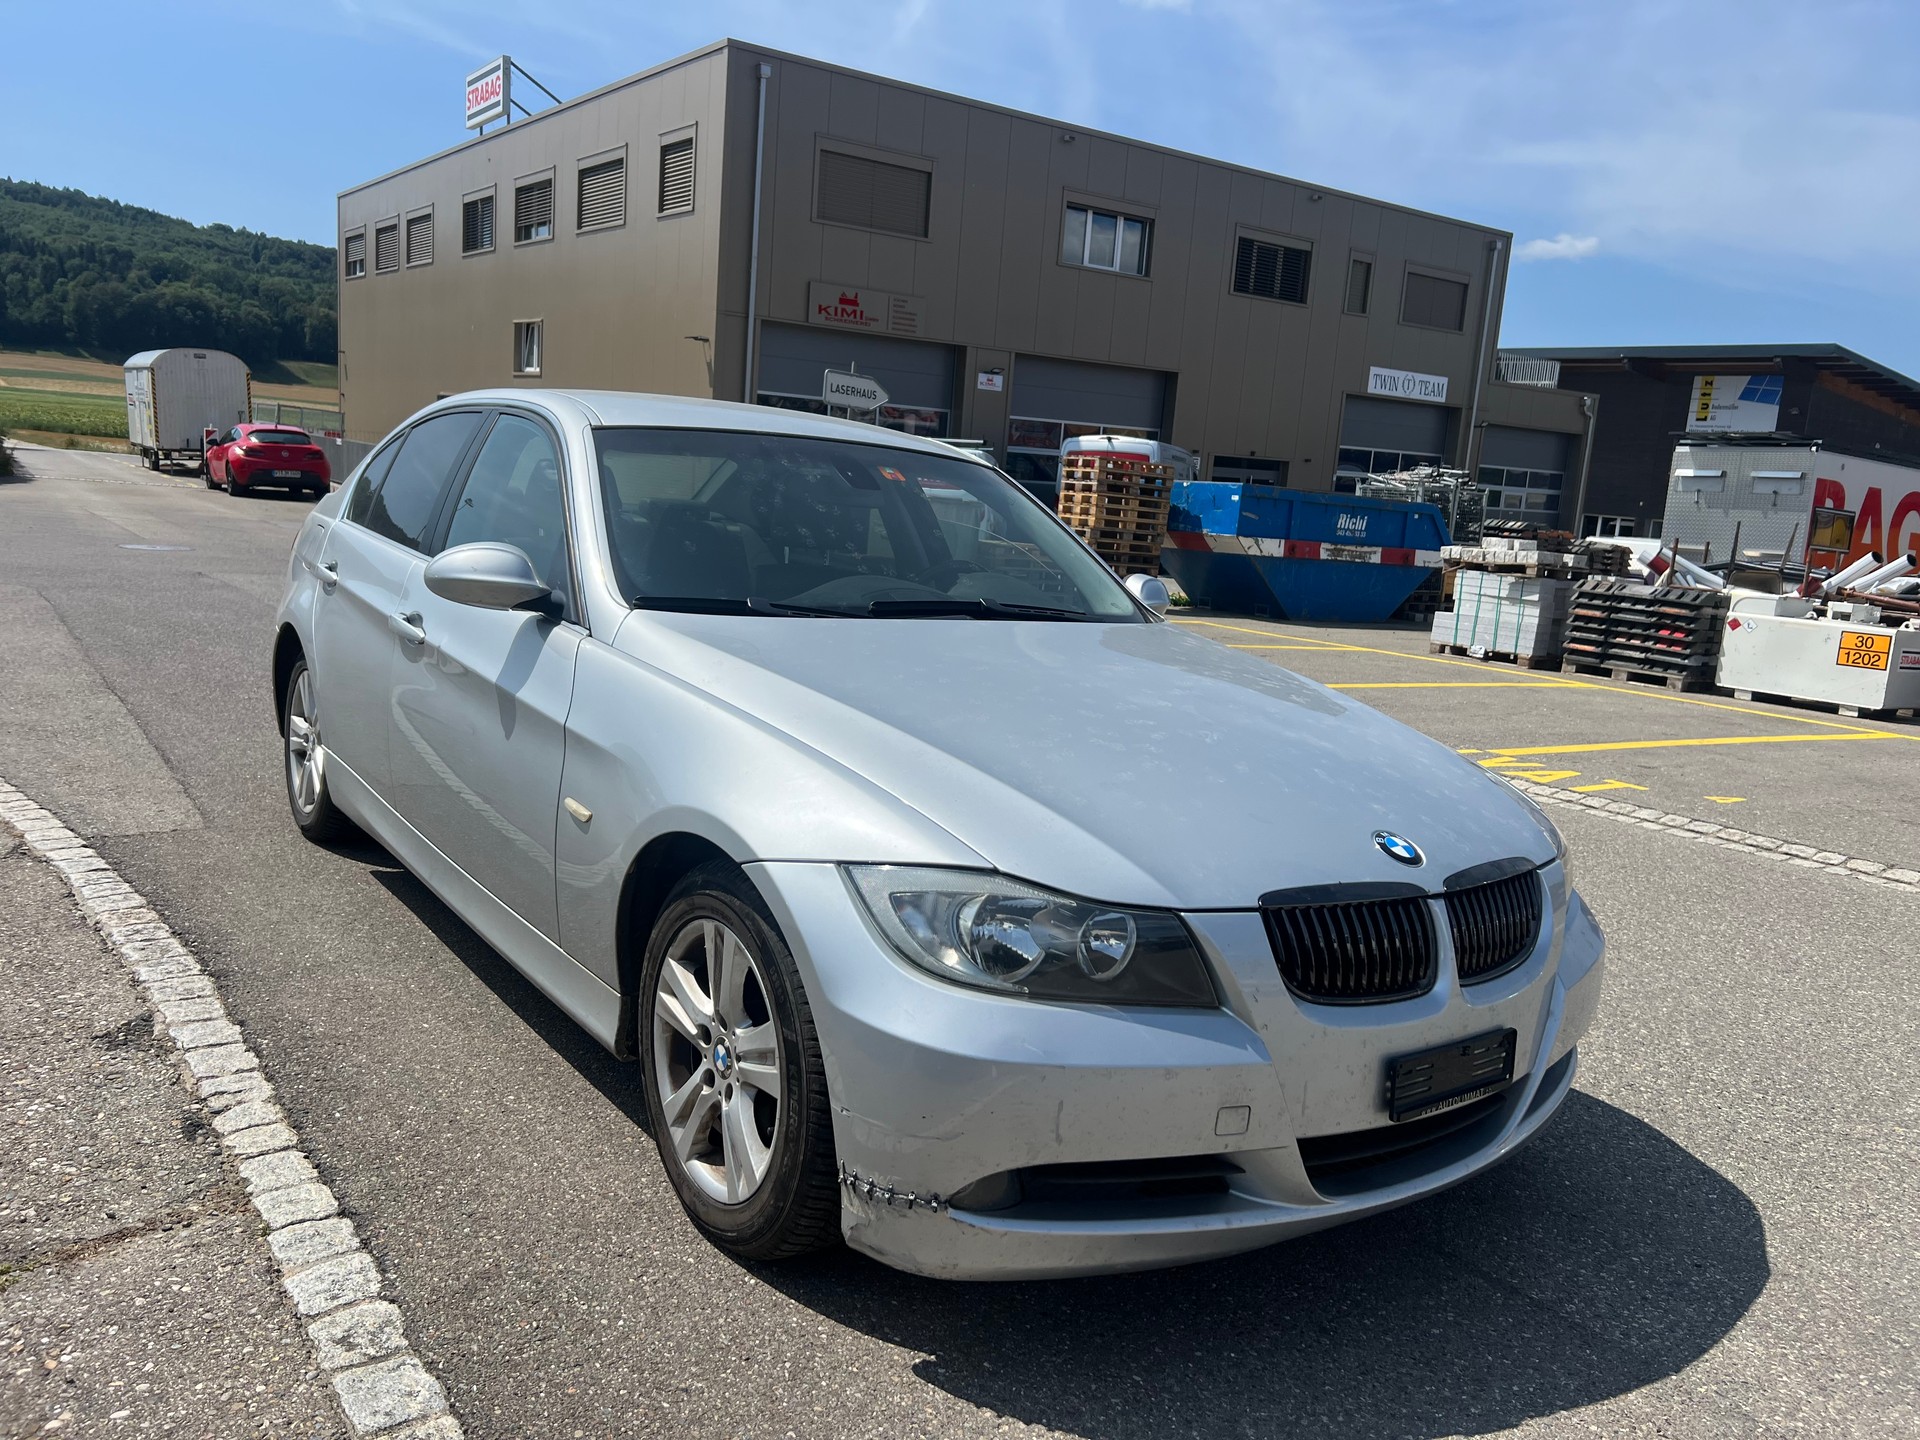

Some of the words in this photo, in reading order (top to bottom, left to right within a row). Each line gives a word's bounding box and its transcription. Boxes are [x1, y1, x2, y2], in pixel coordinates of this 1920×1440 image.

[467, 75, 501, 111] STRABAG
[818, 304, 864, 321] KIMI
[830, 383, 877, 400] LASERHAUS
[1373, 374, 1400, 392] TWIN
[1419, 380, 1445, 398] TEAM
[1337, 513, 1368, 530] Richi
[1854, 636, 1875, 650] 30
[1844, 651, 1881, 667] 1202
